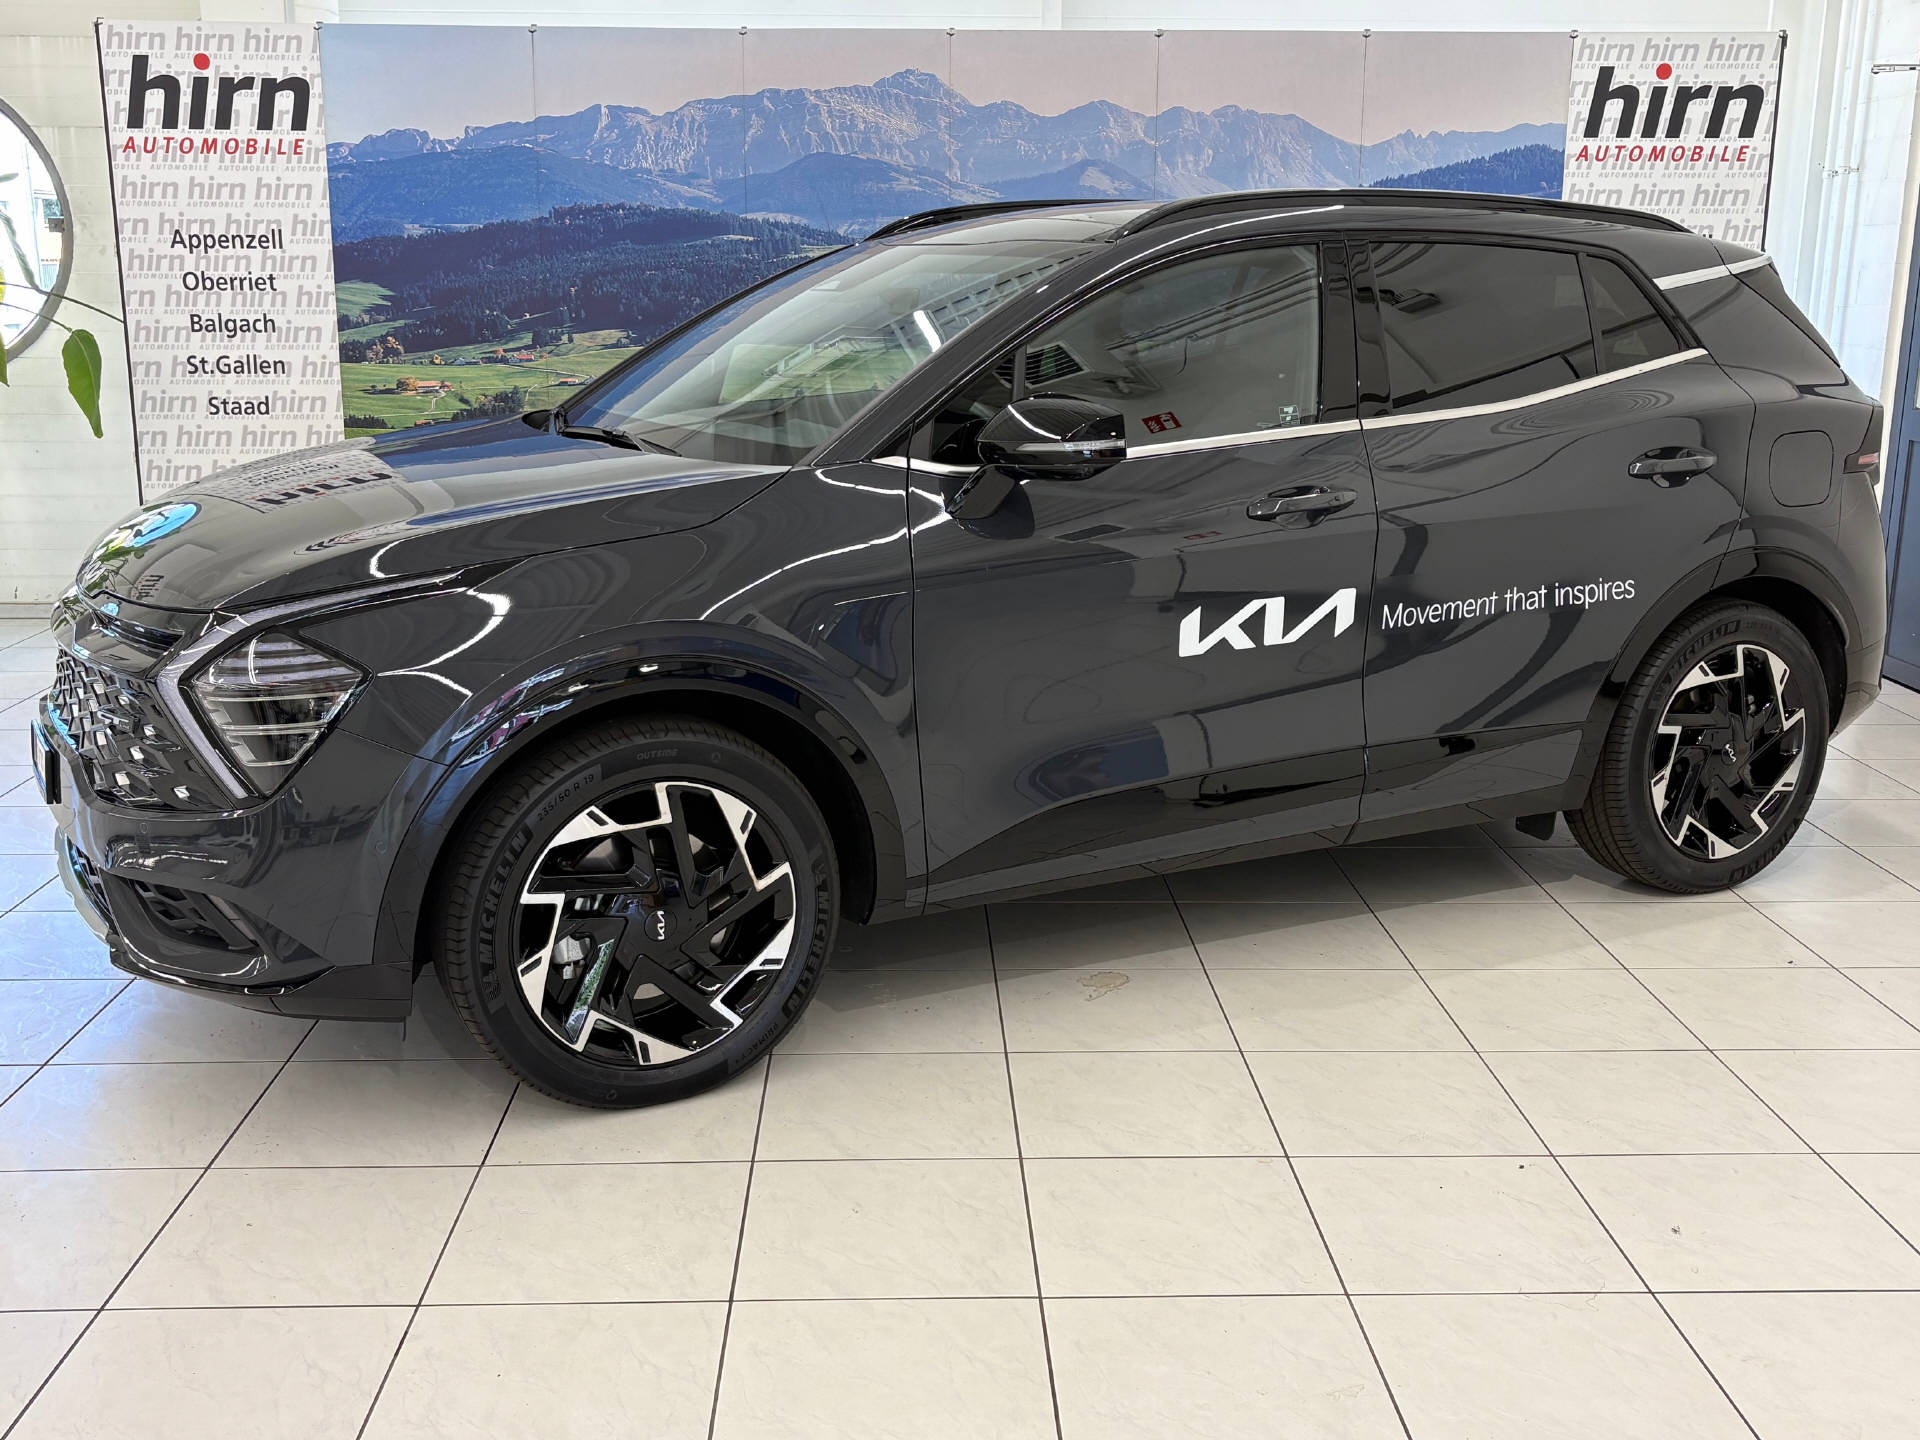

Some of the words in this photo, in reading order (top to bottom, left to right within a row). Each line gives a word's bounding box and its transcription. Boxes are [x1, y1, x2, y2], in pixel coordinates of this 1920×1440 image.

[106, 24, 166, 50] hirn
[176, 26, 234, 51] hirn
[244, 28, 302, 52] hirn
[1577, 37, 1634, 62] hirn
[1641, 37, 1699, 62] hirn
[1706, 37, 1765, 62] hirn
[127, 53, 310, 130] hirn
[1584, 63, 1764, 138] hirn
[122, 136, 304, 155] AUTOMOBILE
[1576, 145, 1750, 162] AUTOMOBILE
[120, 175, 178, 199] hirn
[188, 176, 246, 200] hirn
[255, 177, 312, 200] hirn
[1568, 182, 1622, 206] hirn
[1629, 183, 1684, 206] hirn
[1692, 183, 1750, 206] hirn
[158, 212, 215, 236] hirn
[170, 229, 283, 254] Appenzell
[128, 248, 184, 271] hirn
[194, 248, 251, 272] hirn
[260, 249, 317, 272] hirn
[182, 270, 277, 291] Oberriet
[134, 319, 191, 342] hirn
[190, 312, 276, 338] Balgach
[186, 354, 286, 374] St.Gallen
[140, 390, 197, 412] hirn
[271, 390, 326, 412] hirn
[208, 395, 270, 416] Staad
[176, 424, 232, 447] hirn
[240, 424, 296, 447] hirn
[146, 458, 202, 481] hirn
[1381, 596, 1498, 630] Movement
[1504, 588, 1547, 612] that
[1554, 578, 1636, 610] inspires
[1178, 588, 1356, 657] KIA
[480, 830, 527, 964] MICHELIN
